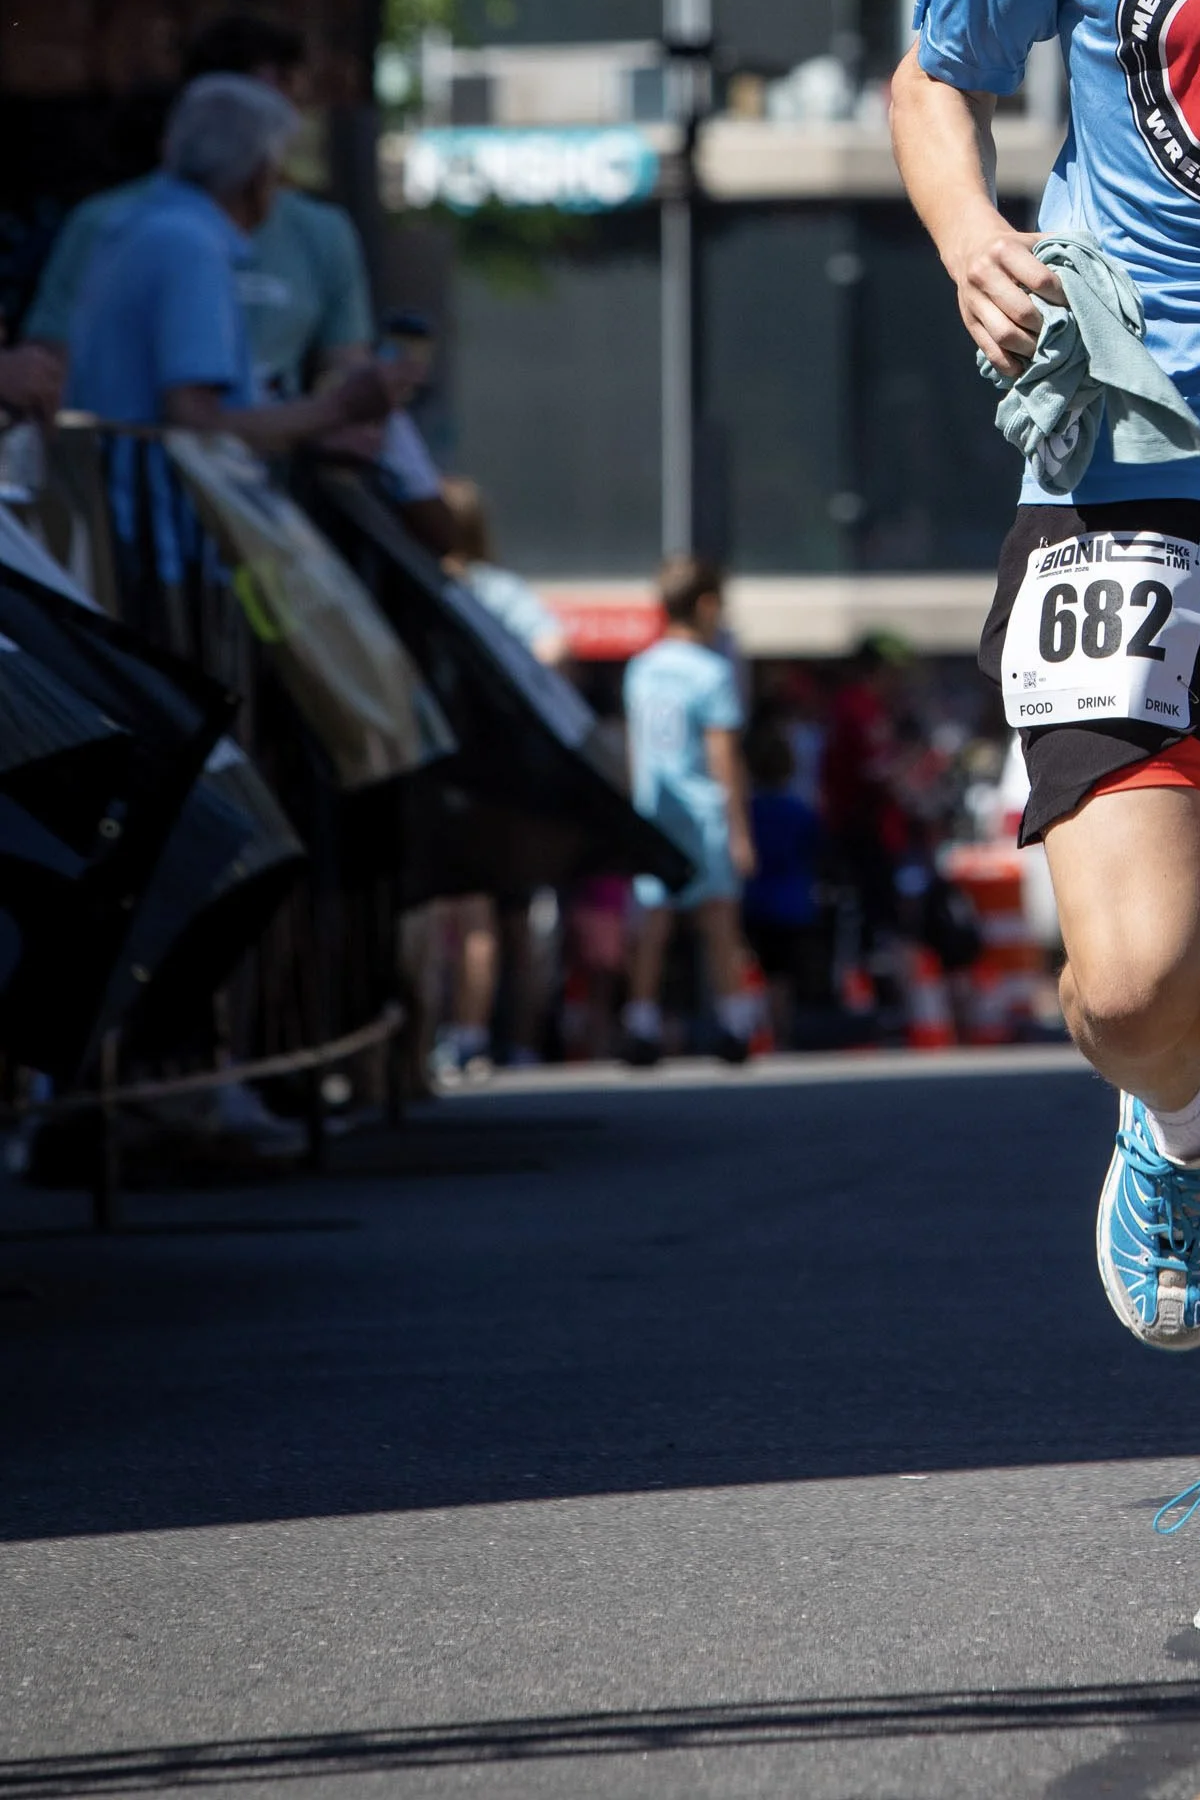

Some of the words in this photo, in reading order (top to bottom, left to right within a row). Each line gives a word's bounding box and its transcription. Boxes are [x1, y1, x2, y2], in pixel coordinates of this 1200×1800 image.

[1039, 539, 1166, 573] BIONIC
[1039, 579, 1173, 663] 682
[1019, 702, 1053, 716] FOOD
[1077, 695, 1116, 710] DRINK
[1145, 698, 1180, 716] DRINK
